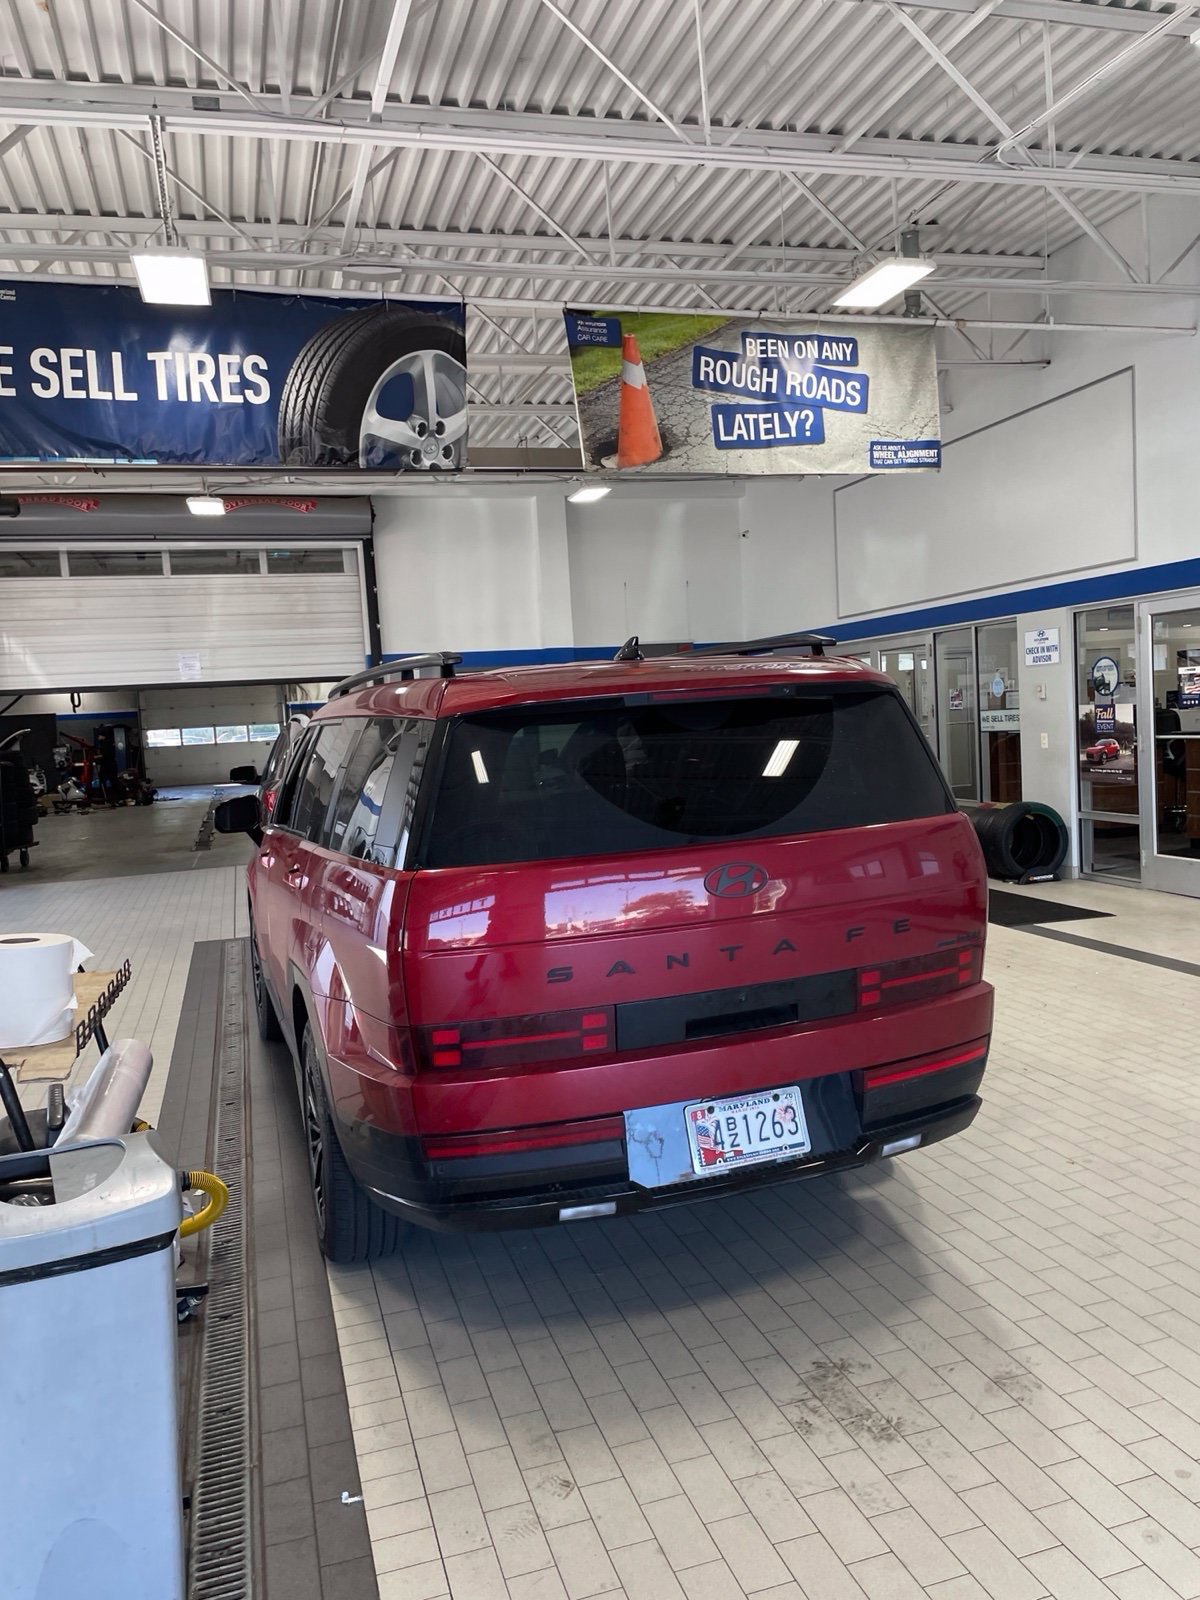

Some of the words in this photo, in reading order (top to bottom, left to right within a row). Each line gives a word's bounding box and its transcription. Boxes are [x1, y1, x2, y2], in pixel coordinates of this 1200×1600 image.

[577, 325, 608, 334] Assurance
[745, 338, 789, 358] BEEN
[794, 340, 819, 359] ON
[821, 342, 853, 361] ANY
[0, 346, 17, 397] E
[30, 347, 138, 400] SELL
[147, 351, 271, 405] TIRES
[699, 356, 778, 394] ROUGH
[785, 371, 861, 407] ROADS
[717, 409, 815, 441] LATELY?
[873, 451, 896, 459] WHEEL
[898, 449, 938, 458] ALIGNMENT
[59, 497, 88, 510] DOOR
[280, 498, 307, 510] DOOR
[1025, 647, 1040, 655] CHECK
[1046, 644, 1058, 653] WITH
[1032, 654, 1052, 663] ADVISOR
[982, 715, 990, 723] WE
[1004, 714, 1020, 722] TIRES
[1096, 707, 1114, 719] Fall
[546, 938, 798, 984] SANTA
[845, 918, 911, 943] FE
[719, 1097, 771, 1112] MARYLAND
[697, 1111, 703, 1119] 8
